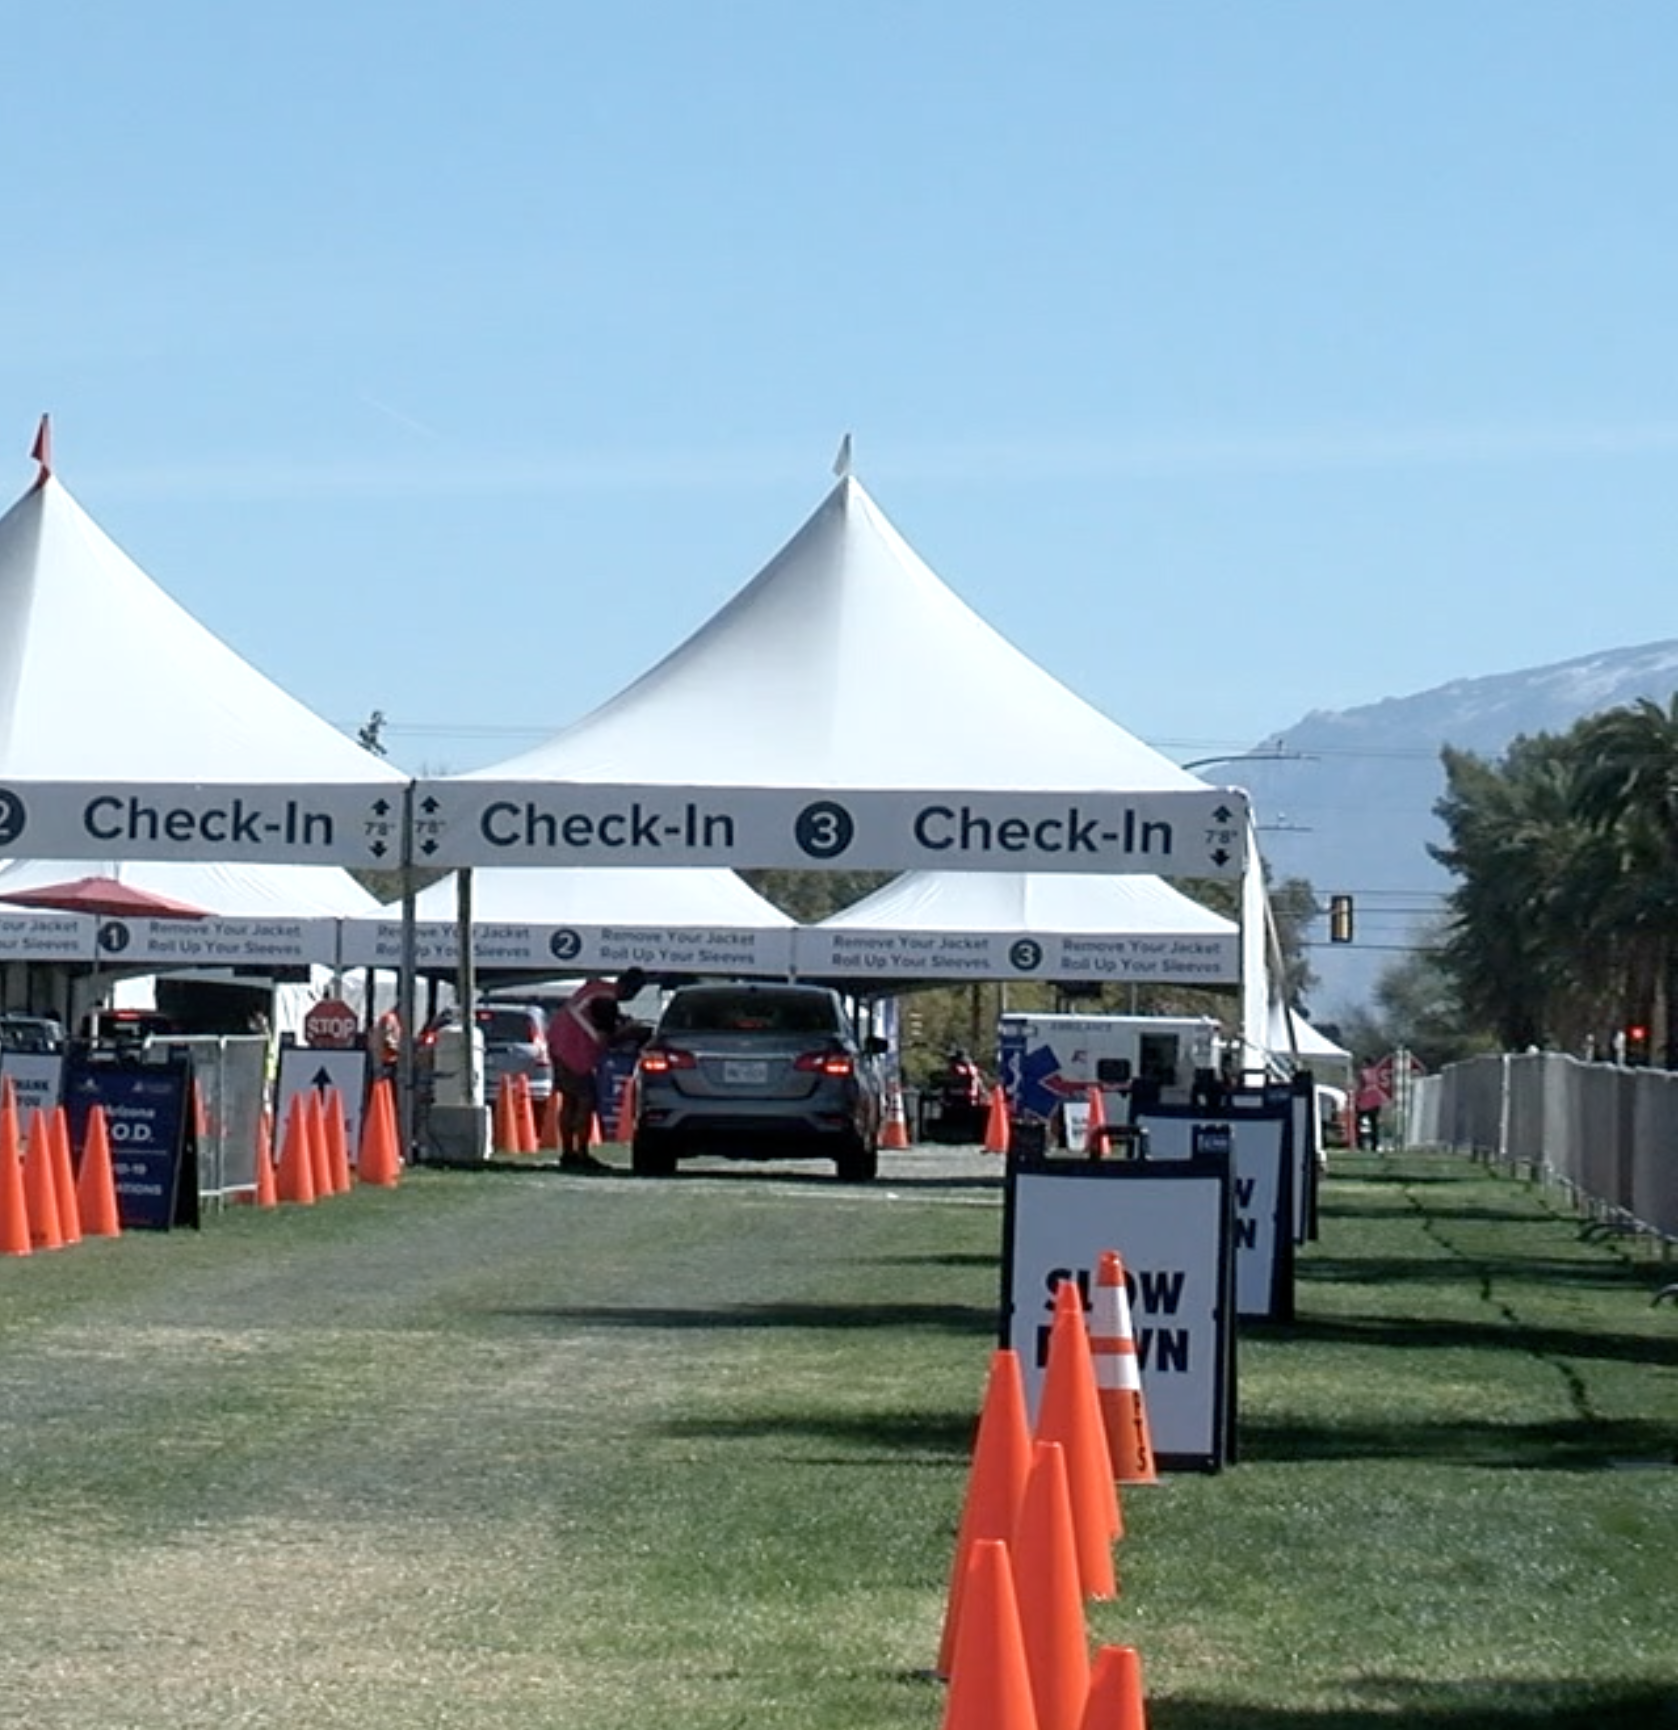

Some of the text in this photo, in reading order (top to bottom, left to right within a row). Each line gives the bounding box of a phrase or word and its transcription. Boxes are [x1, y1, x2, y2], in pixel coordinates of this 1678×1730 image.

[83, 795, 334, 846] Check-In
[480, 801, 734, 848] Check-In
[913, 805, 1172, 855] Check-In
[30, 919, 79, 934] Jacket
[149, 921, 301, 938] Remove Your Jacket
[482, 926, 530, 940] Jacket
[23, 936, 79, 950] Sleeves
[601, 928, 755, 945] Remove Your Jacket
[832, 935, 989, 952] Remove Your Jacket
[147, 939, 301, 955] Roll Up Your Sleeves
[474, 944, 530, 958] Sleeves
[600, 946, 755, 964] Roll Up Your Sleeves
[1062, 938, 1221, 955] Remove Your Jacket
[832, 953, 989, 969] Roll Up Your Sleeves
[1060, 956, 1221, 973] Roll Up Your Sleeves
[307, 1016, 355, 1038] STOP
